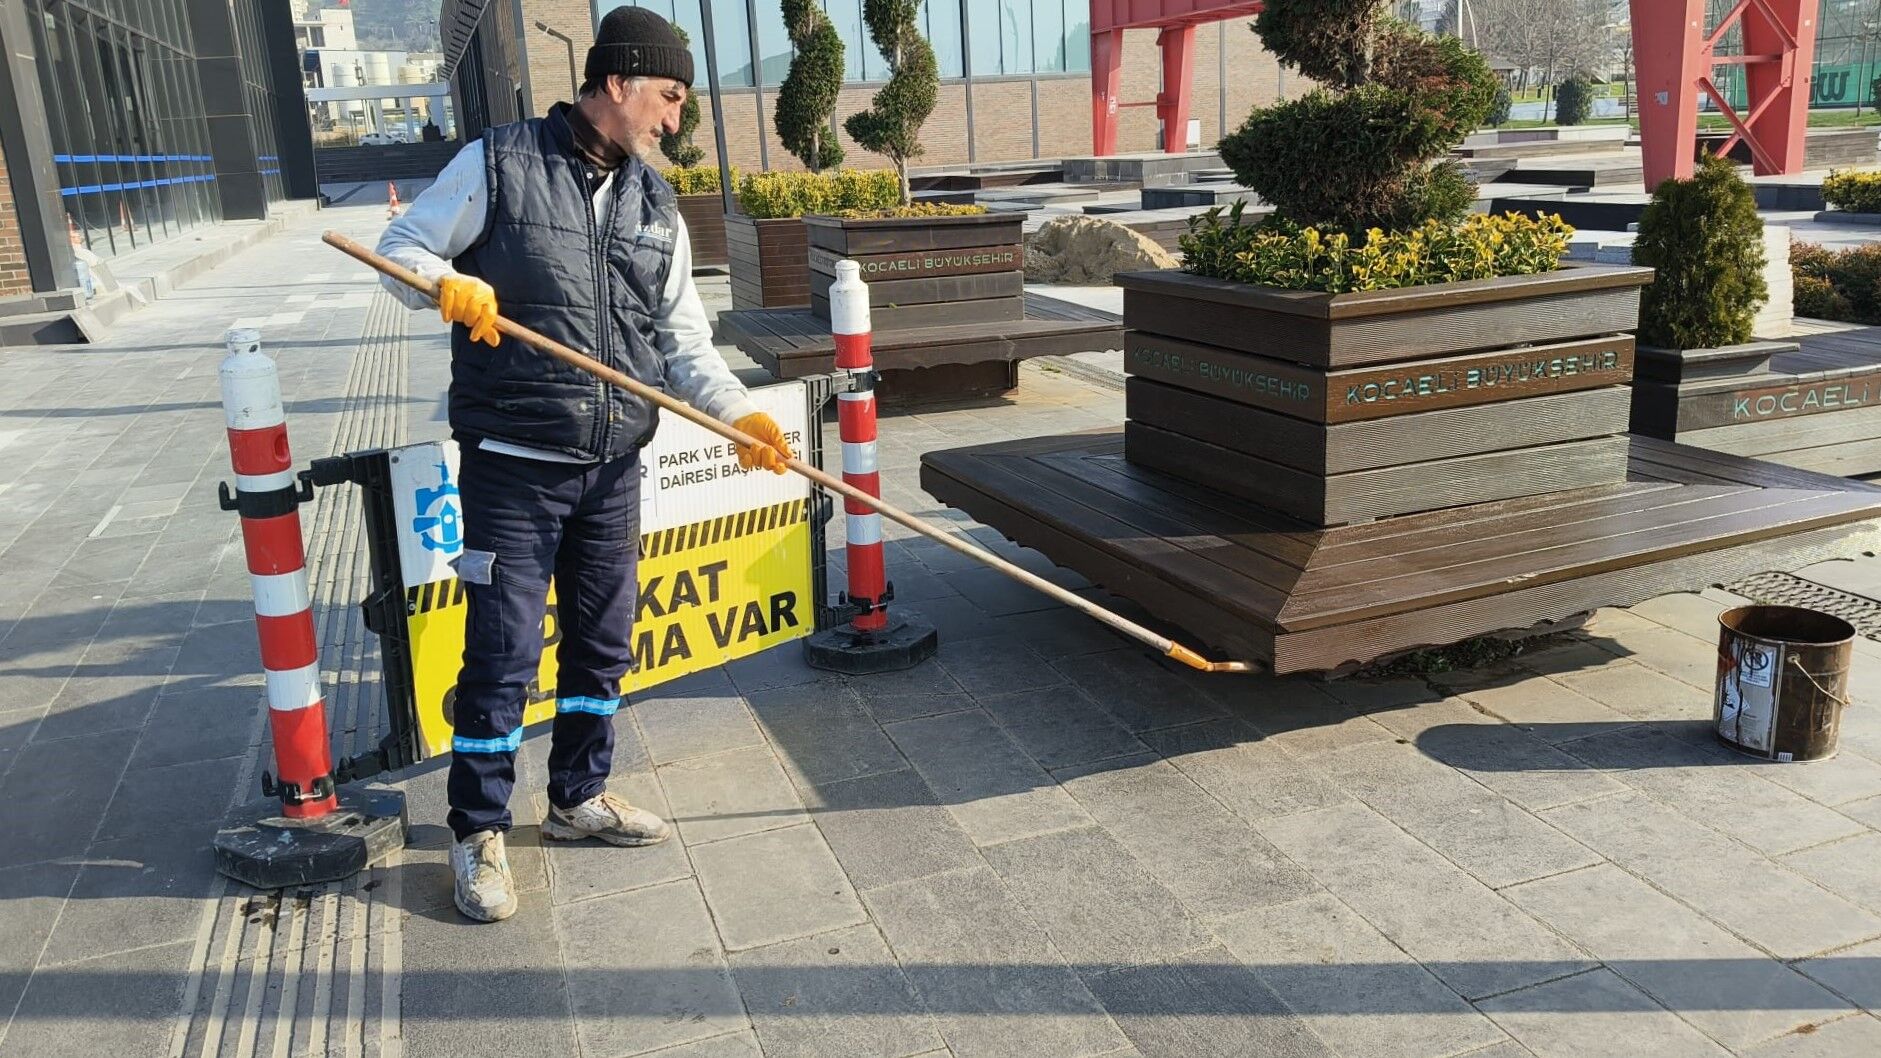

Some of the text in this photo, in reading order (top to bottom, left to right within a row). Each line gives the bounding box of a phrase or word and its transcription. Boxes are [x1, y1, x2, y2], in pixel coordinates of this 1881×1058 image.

[924, 252, 1014, 269] BÜYÜKŞEHİR
[1346, 372, 1458, 405] KOCAELİ
[1733, 382, 1869, 419] KOCAELİ
[659, 449, 700, 469] PARK
[703, 444, 722, 461] VE
[660, 463, 718, 490] DAİRESİ
[706, 591, 799, 649] VAR
